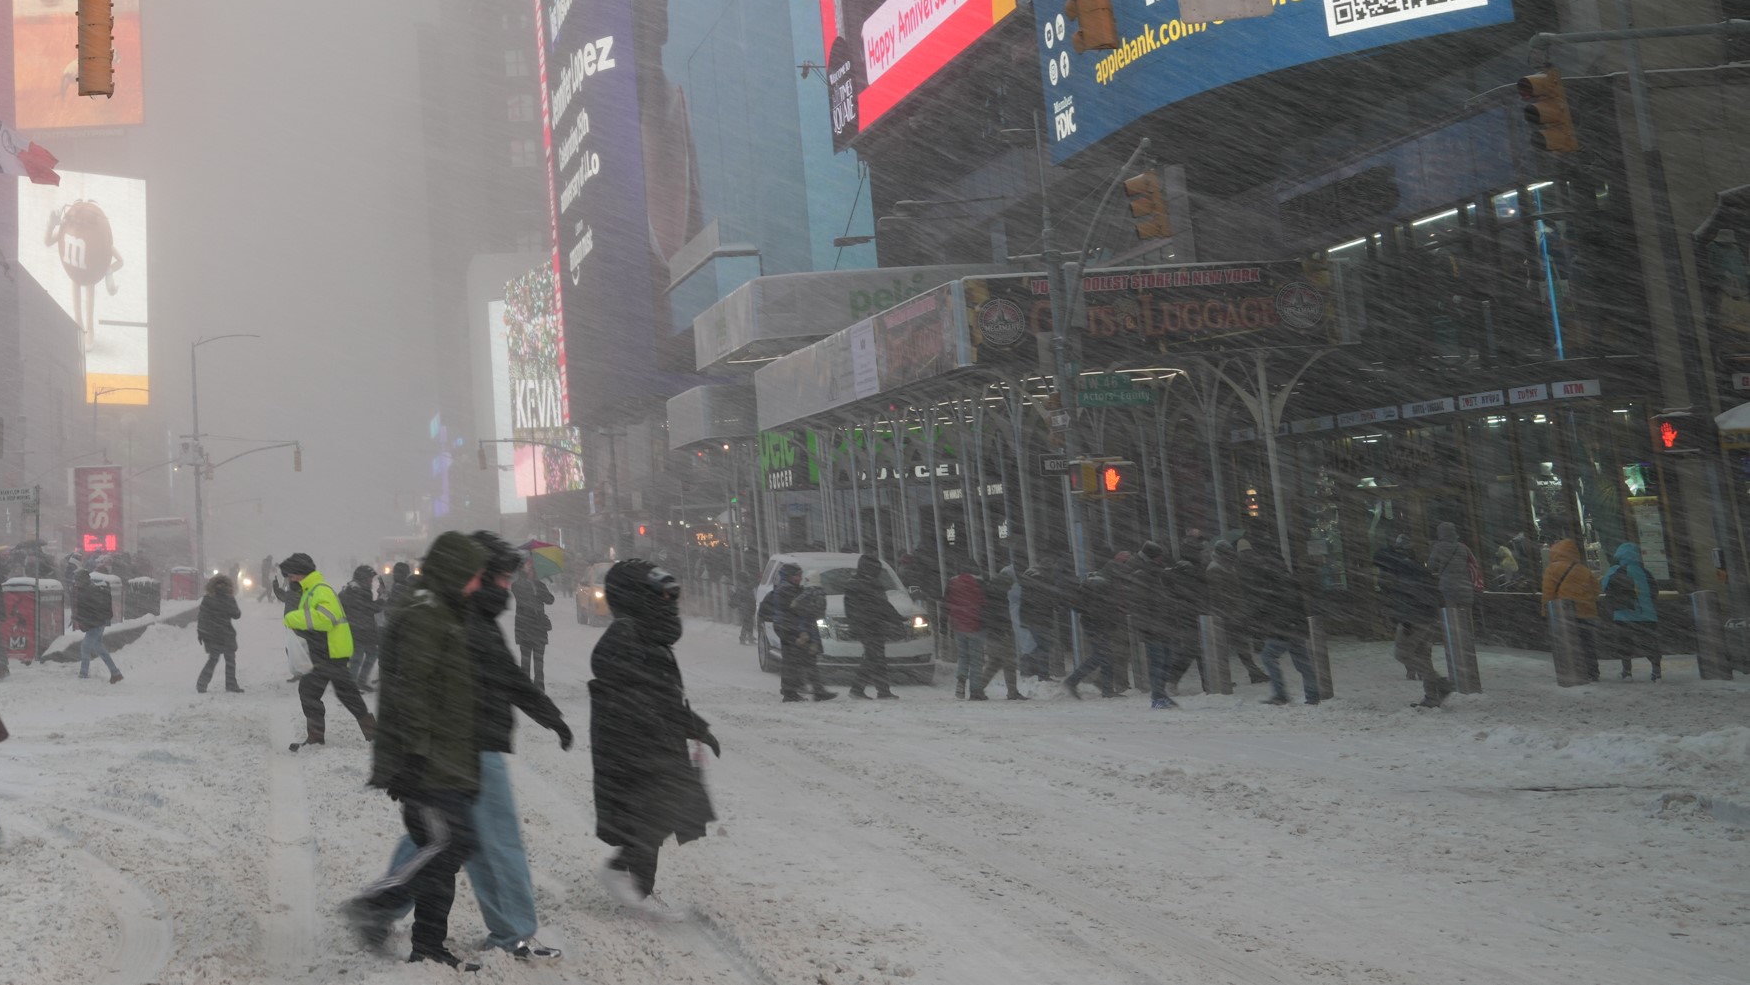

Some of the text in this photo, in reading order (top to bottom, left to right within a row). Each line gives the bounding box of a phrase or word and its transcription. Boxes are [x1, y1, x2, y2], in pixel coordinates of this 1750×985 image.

[570, 35, 615, 94] Lopez
[867, 24, 895, 70] Happy
[1055, 107, 1076, 142] FDIC
[63, 234, 87, 270] m
[1083, 268, 1260, 293] OOLEST STORE IN NEW YORK
[1137, 293, 1277, 336] LUGGAGE
[1120, 391, 1151, 403] Equity
[1563, 383, 1584, 395] ATM
[768, 469, 793, 490] SOCCER
[88, 472, 114, 529] tkts
[9, 635, 26, 651] MJ
